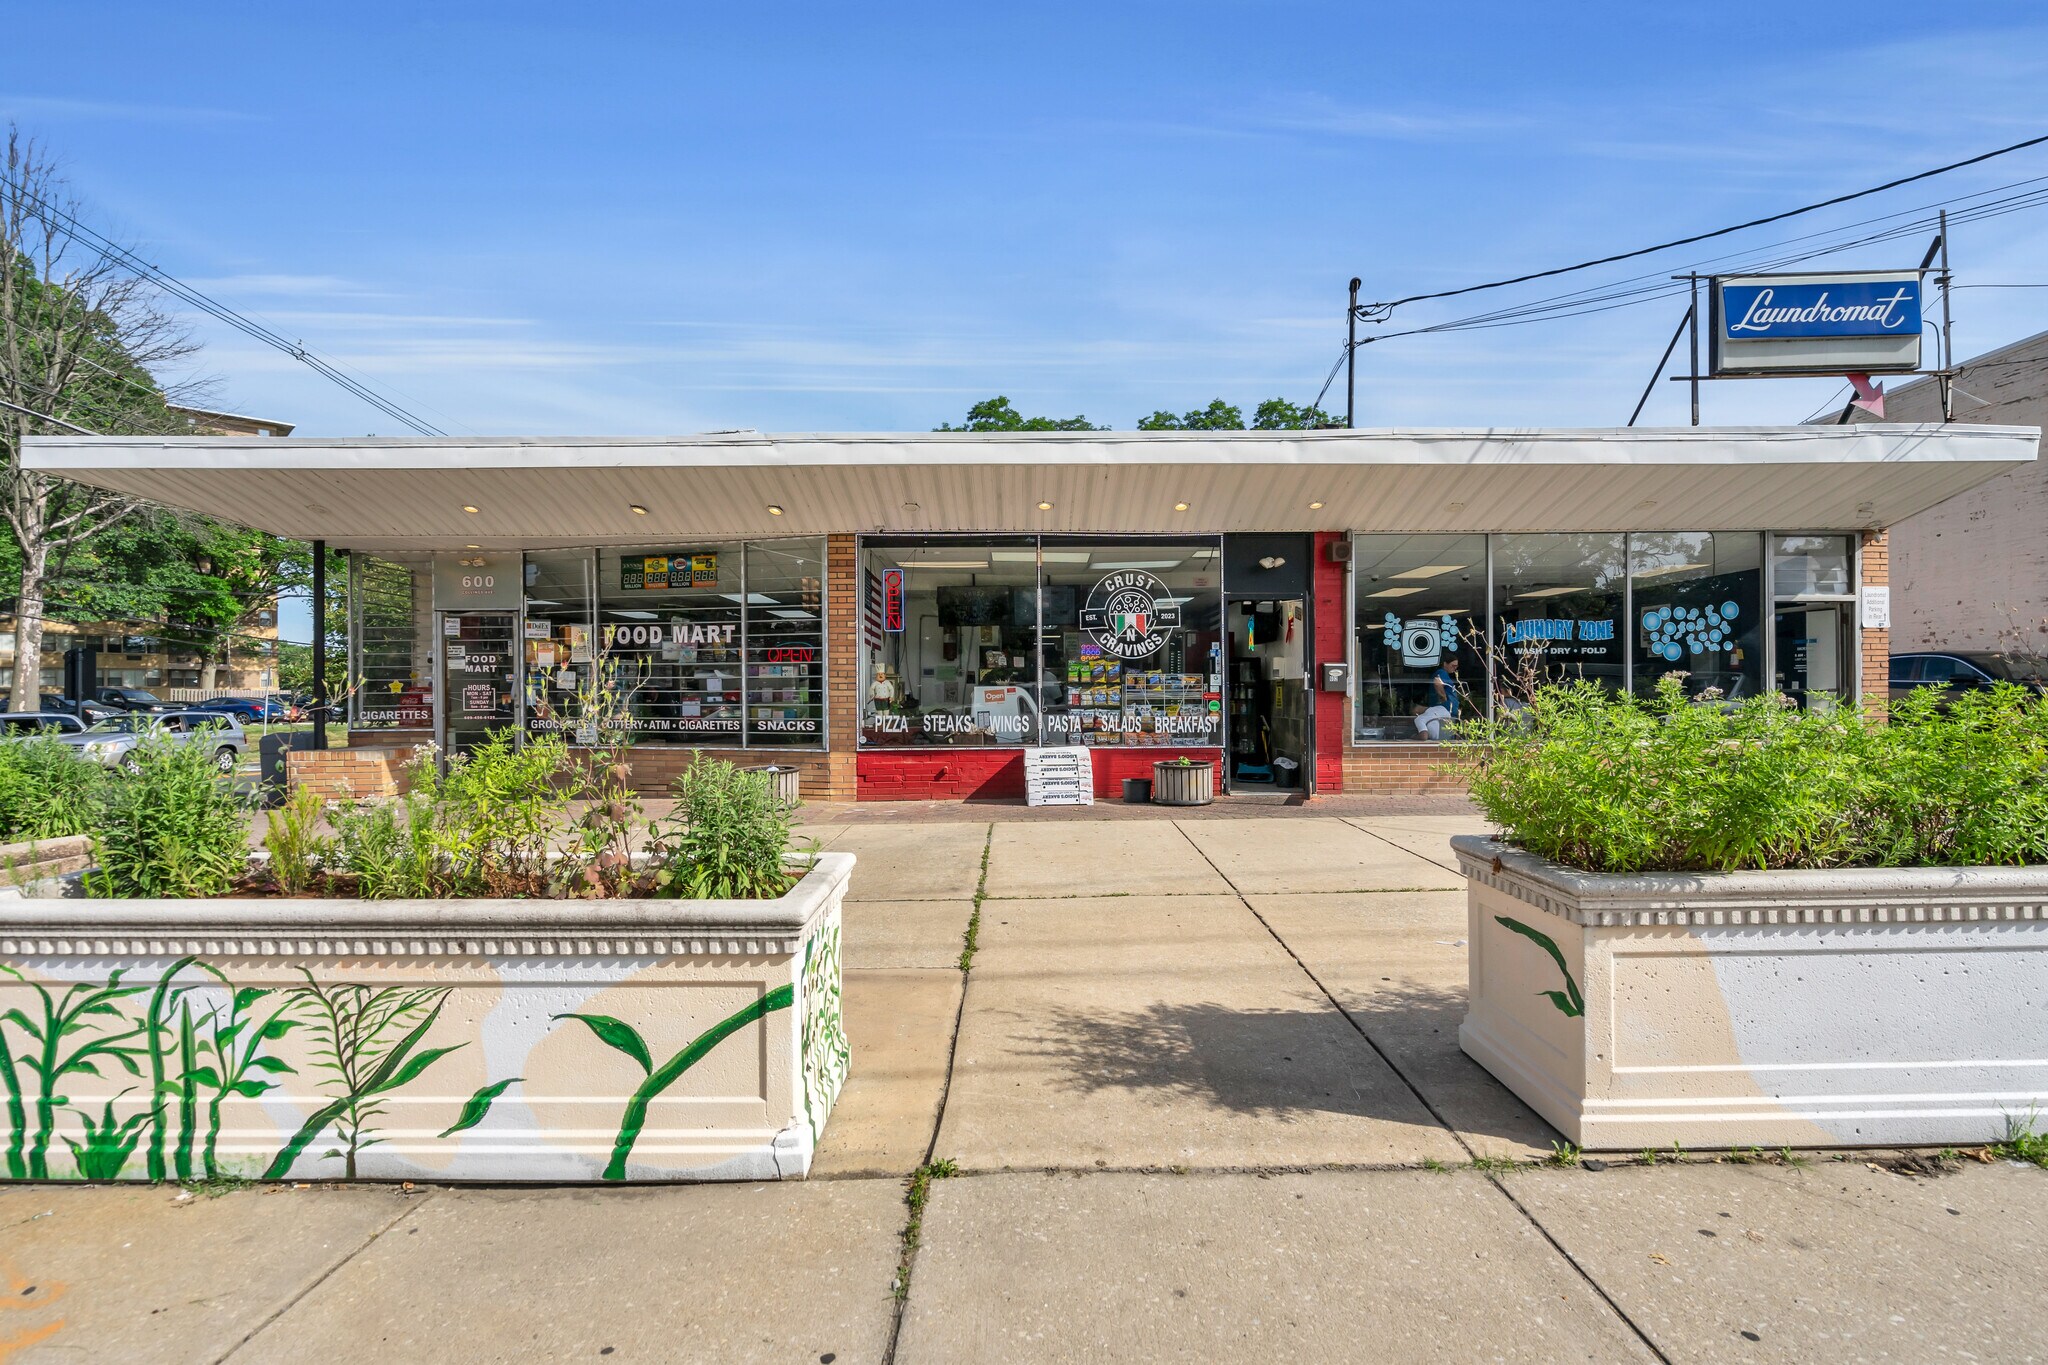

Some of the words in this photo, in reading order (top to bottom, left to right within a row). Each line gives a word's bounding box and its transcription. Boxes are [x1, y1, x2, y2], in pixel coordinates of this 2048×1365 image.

[1730, 287, 1914, 331] Laundromat
[462, 576, 494, 588] 600
[1104, 573, 1156, 592] CRUST
[885, 571, 902, 629] OPEN
[1160, 612, 1176, 620] 2023
[672, 624, 736, 644] MART
[1126, 629, 1136, 642] N
[1506, 618, 1574, 645] LAUNDRY
[1578, 618, 1615, 641] ZONE
[1099, 632, 1163, 657] CRAVINGS
[1513, 647, 1543, 655] WASH
[1550, 647, 1571, 655] DRY
[465, 655, 496, 663] FOOD
[767, 646, 813, 663] OPEN
[465, 665, 497, 673] MART
[985, 692, 1004, 701] Open
[359, 710, 429, 720] CIGARETTES
[648, 720, 671, 730] ATM
[678, 719, 741, 731] CIGARETTES
[757, 720, 816, 732] SNACKS
[874, 715, 909, 733] PIZZA
[923, 714, 972, 733] STEAKS
[989, 714, 1030, 733] WINGS
[1048, 715, 1082, 733] PASTA
[1101, 715, 1142, 733] SALADS
[1154, 715, 1218, 734] BREAKFAST
